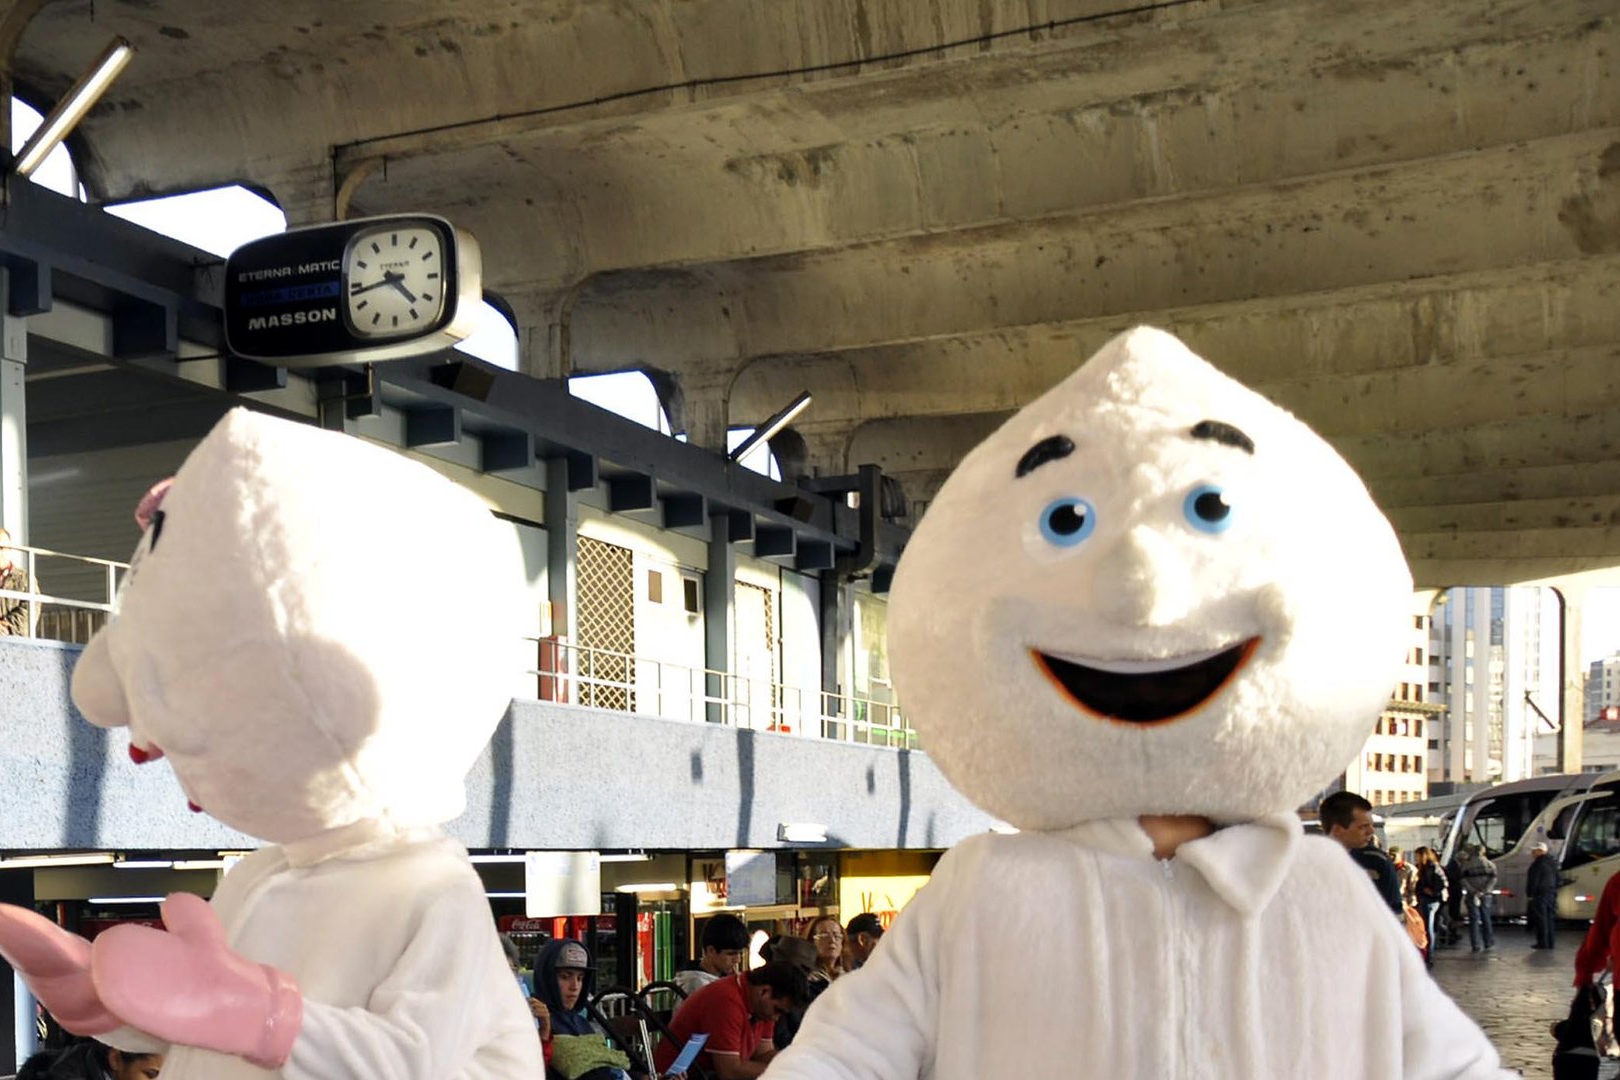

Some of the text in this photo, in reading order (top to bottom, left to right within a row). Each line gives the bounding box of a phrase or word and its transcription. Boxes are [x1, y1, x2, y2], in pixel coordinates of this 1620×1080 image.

[238, 259, 340, 283] ETERNA MATIC
[248, 308, 337, 331] MASSON
